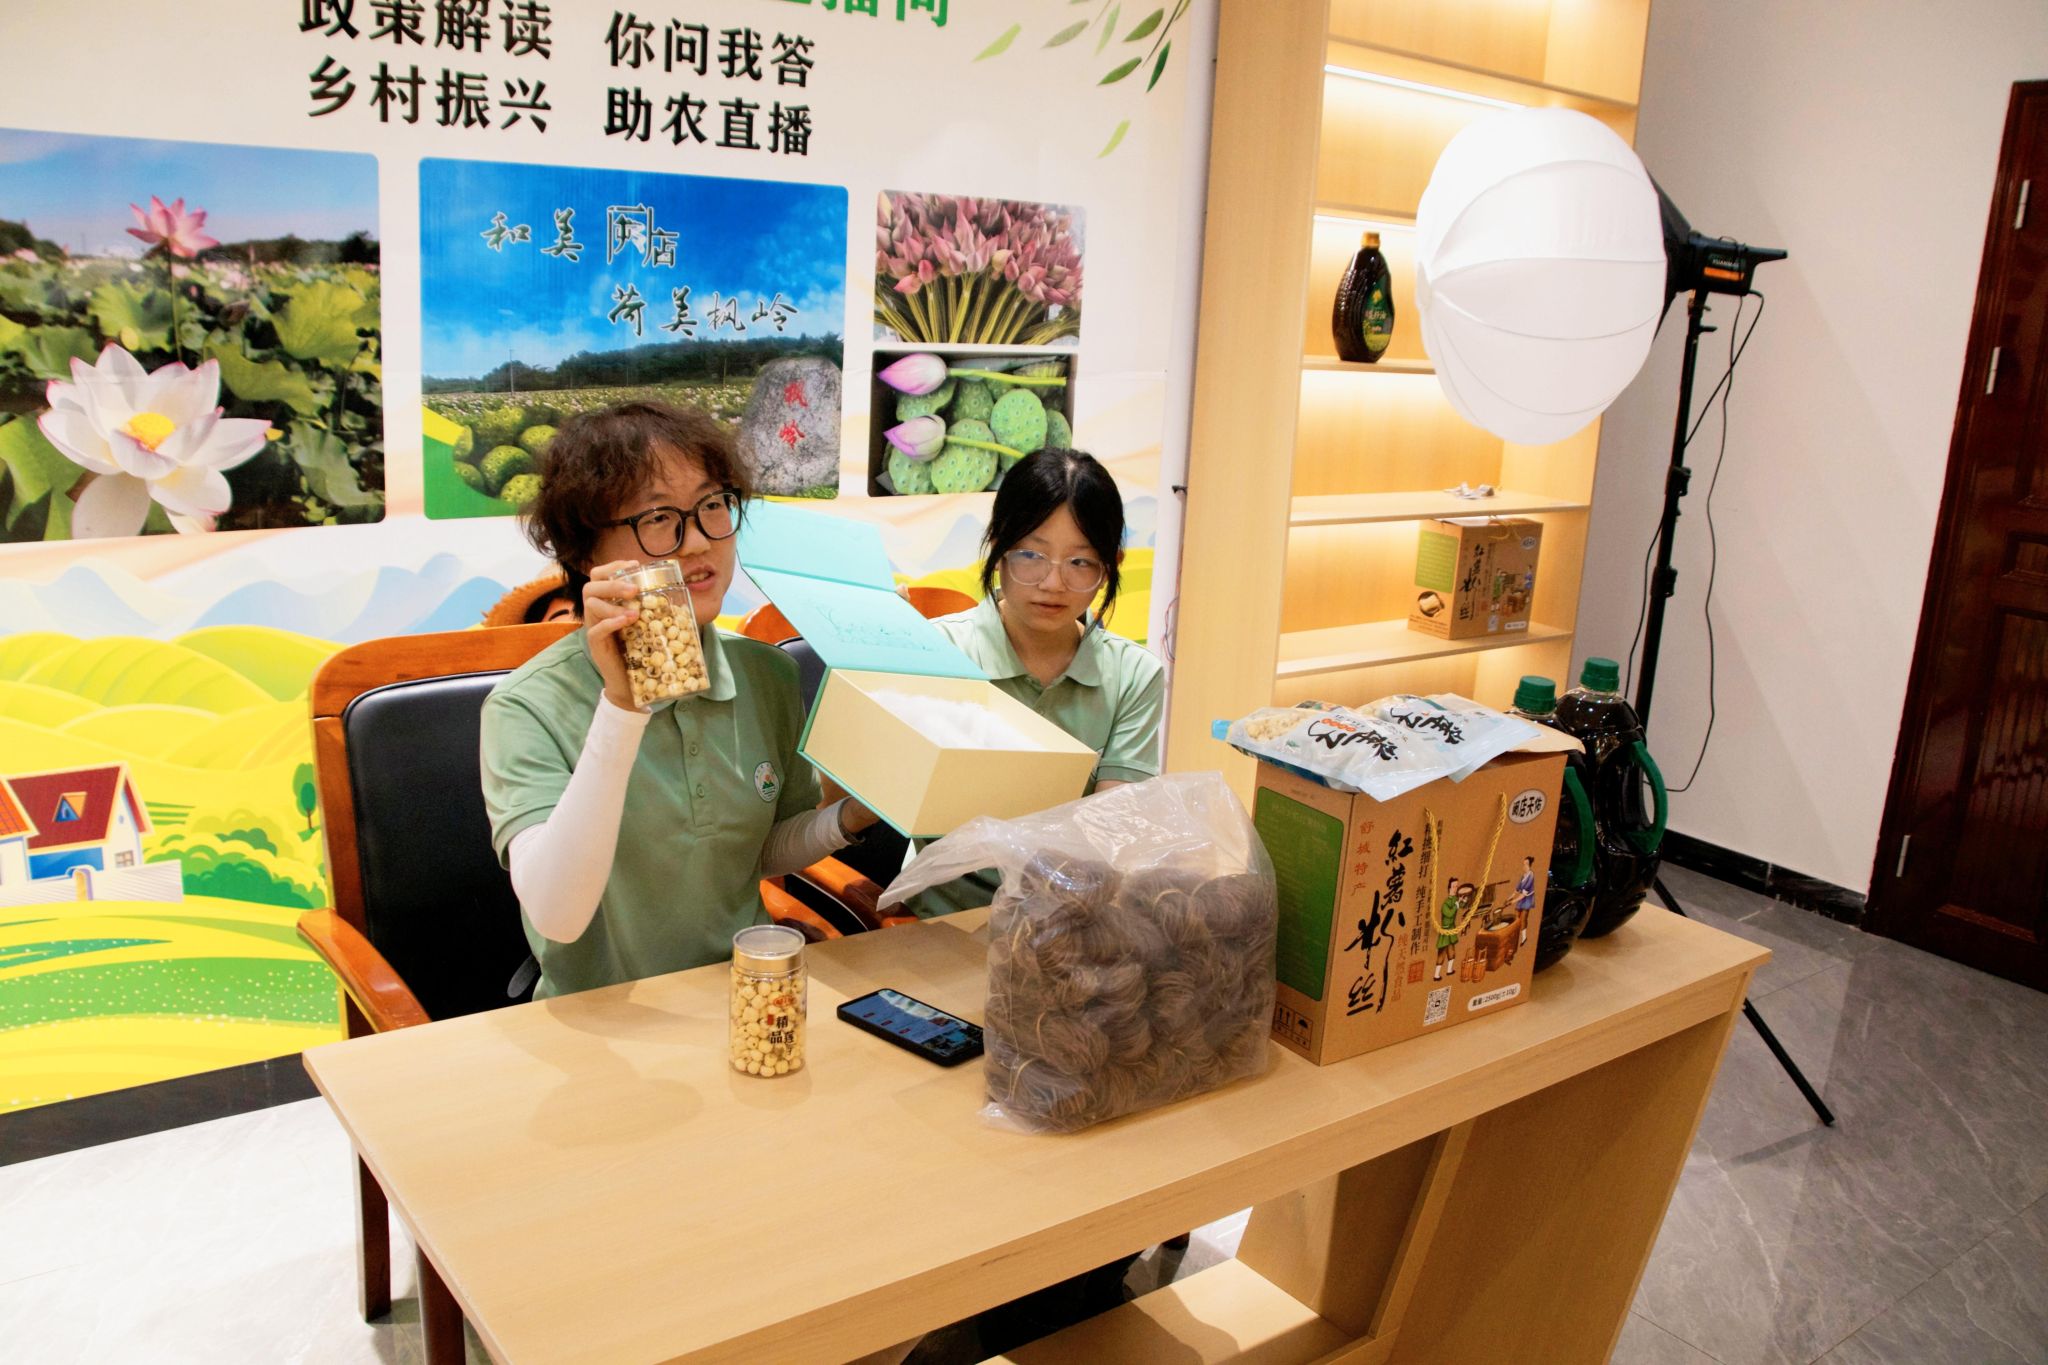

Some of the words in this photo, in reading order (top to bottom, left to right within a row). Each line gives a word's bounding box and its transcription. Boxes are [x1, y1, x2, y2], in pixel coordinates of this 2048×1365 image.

[298, 0, 552, 60] 政策解读
[604, 10, 815, 88] 你问我答
[307, 54, 552, 134] 乡村振兴
[603, 86, 812, 156] 助农直播
[608, 283, 798, 337] 荷美枫岭
[1350, 821, 1374, 897] 舒城特产
